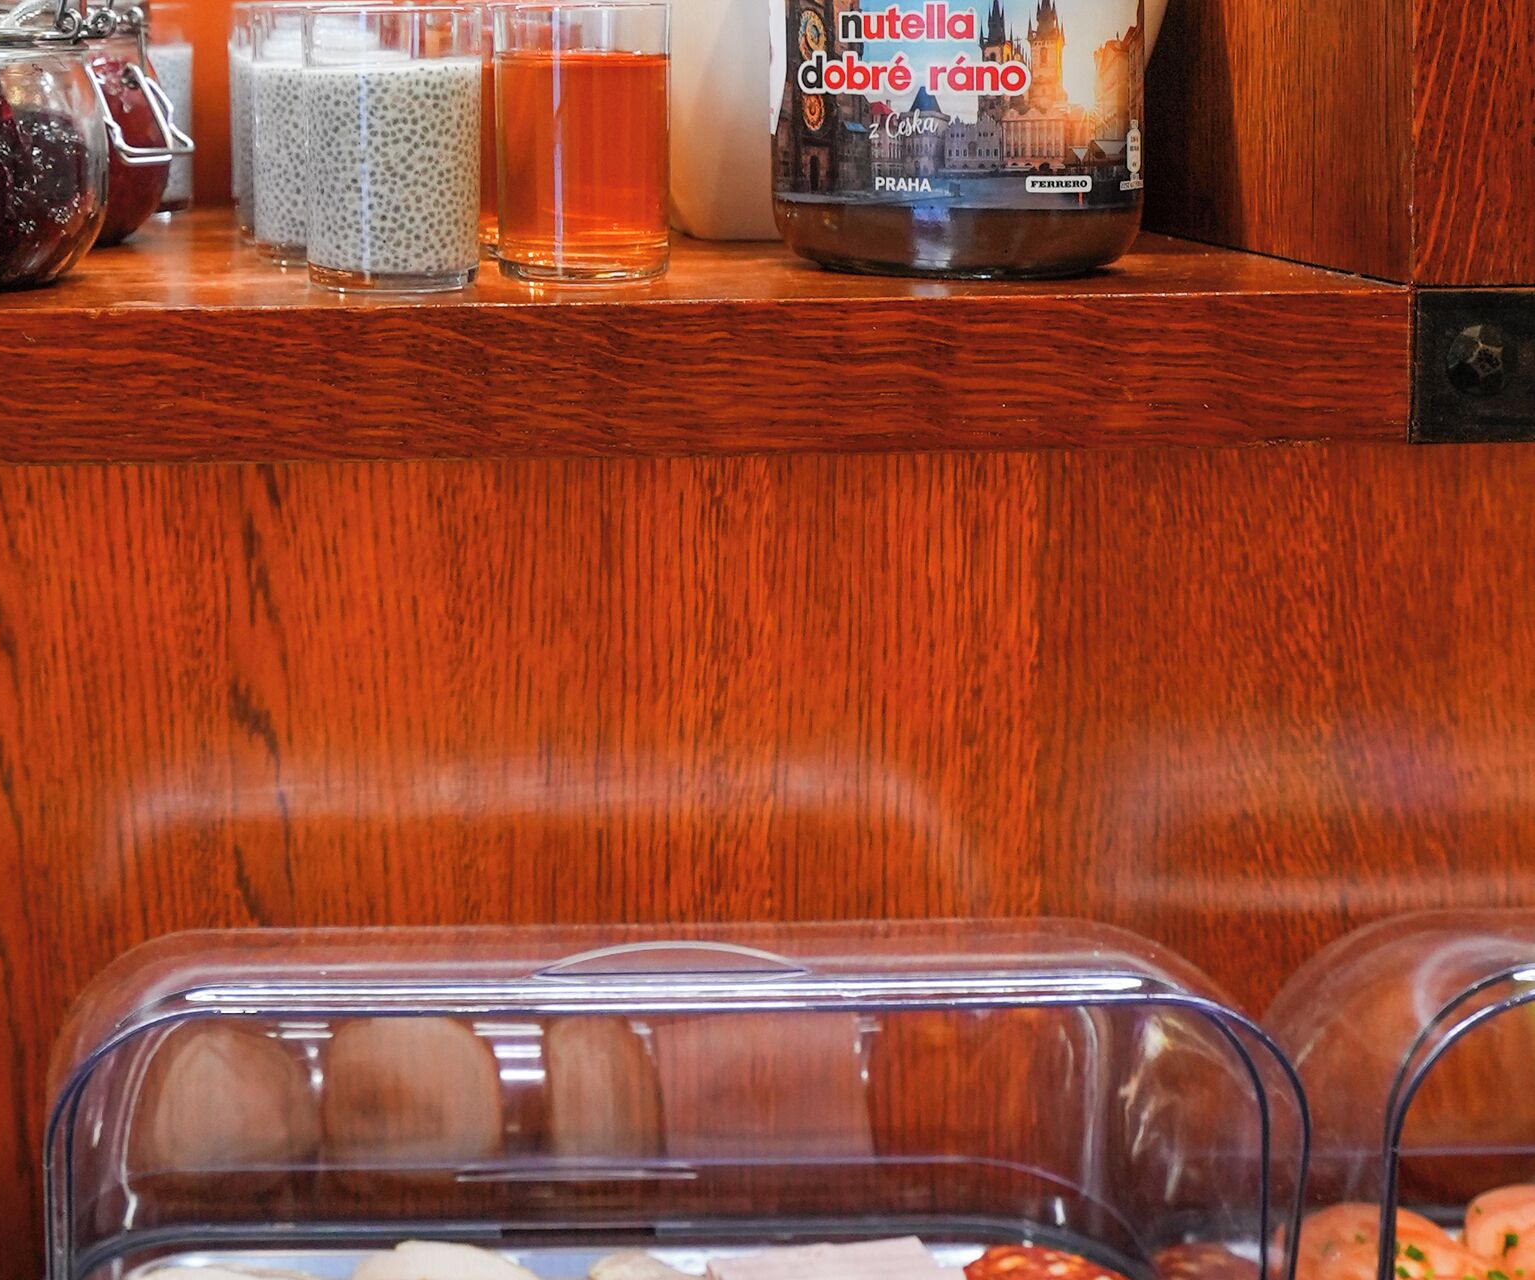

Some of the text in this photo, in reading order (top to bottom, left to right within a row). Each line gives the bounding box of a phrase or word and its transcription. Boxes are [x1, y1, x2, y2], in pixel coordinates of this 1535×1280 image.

[841, 4, 974, 40] nutella
[801, 55, 1027, 92] dobré ráno
[869, 123, 880, 140] z
[875, 176, 932, 192] PRAHA
[1030, 180, 1088, 189] FERRERO
